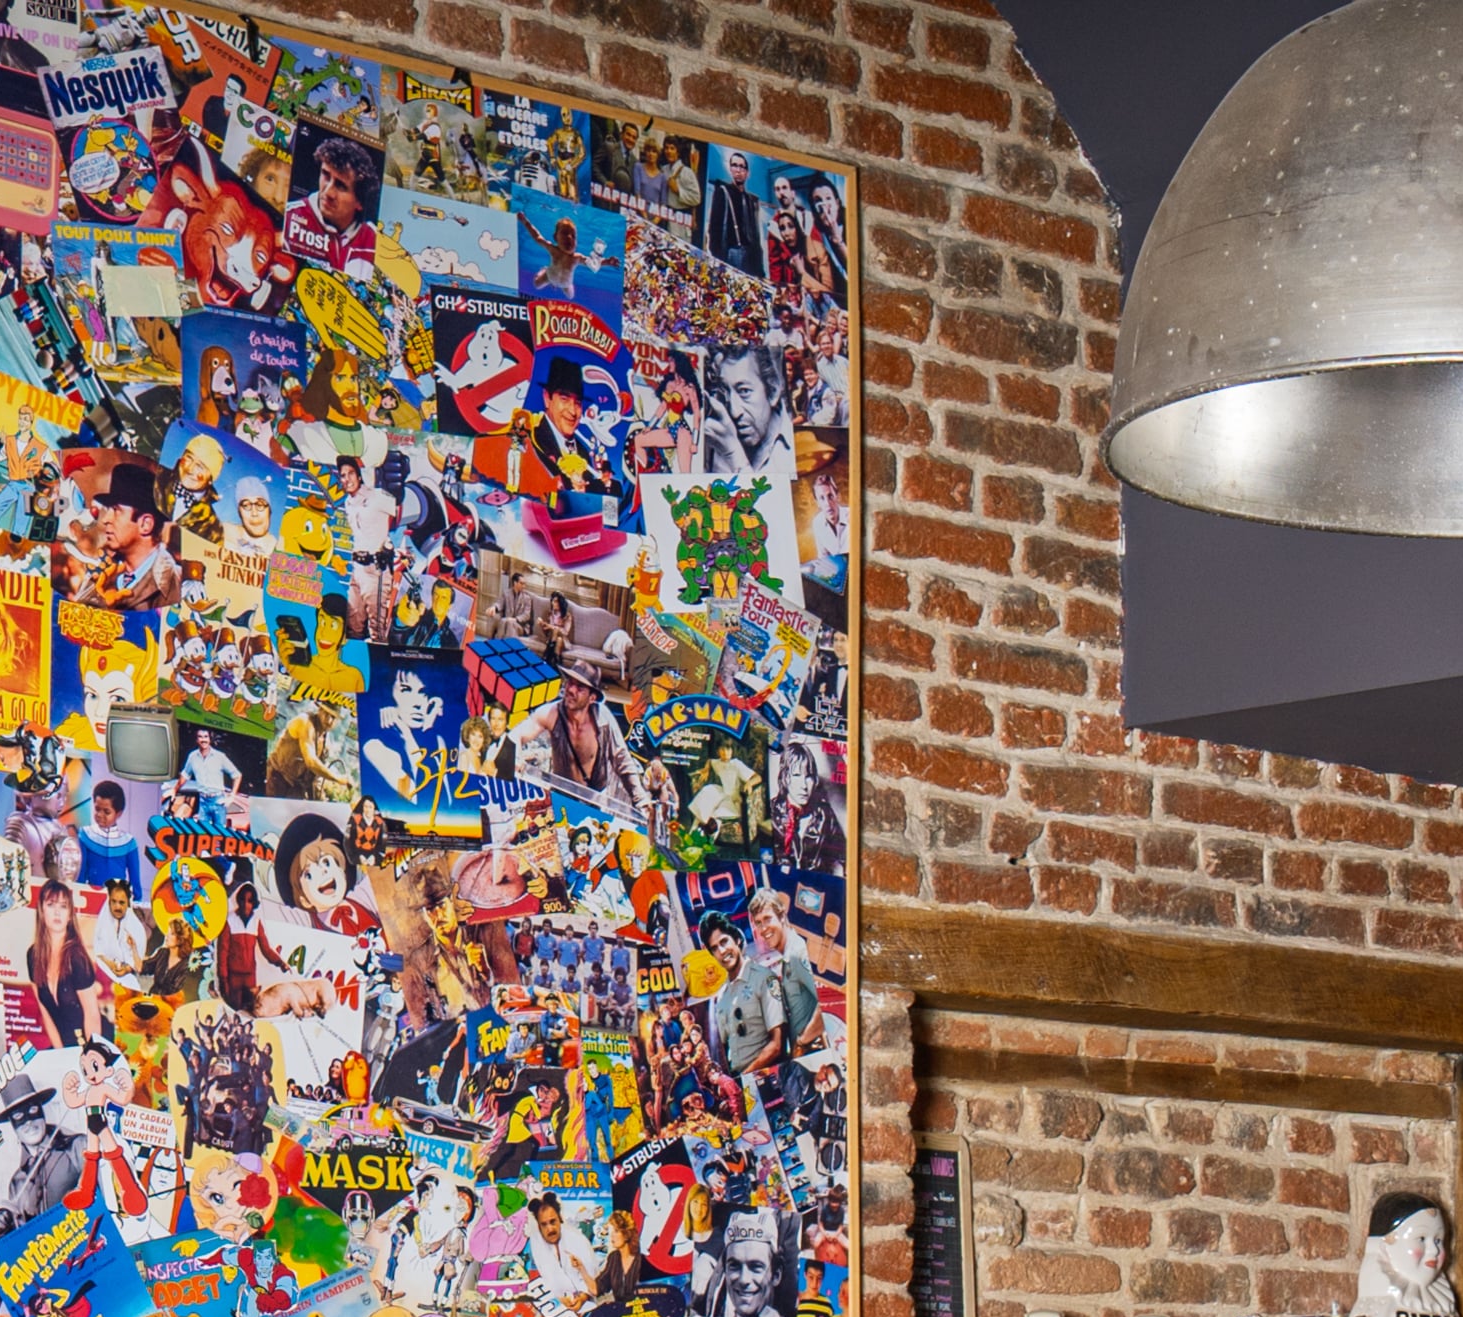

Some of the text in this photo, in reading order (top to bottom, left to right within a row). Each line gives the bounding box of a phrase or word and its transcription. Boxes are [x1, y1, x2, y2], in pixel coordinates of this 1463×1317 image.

[43, 56, 167, 119] Nesquik
[514, 95, 531, 110] LA
[496, 105, 548, 127] GUERRE
[510, 120, 536, 136] DES
[497, 133, 548, 152] ETOILES
[55, 223, 177, 246] TOUT DOUX DINKY
[289, 220, 331, 251] Prost
[536, 305, 618, 354] ROGER RABBIT
[27, 385, 83, 430] DAYS
[742, 583, 809, 634] Fantastic
[11, 698, 26, 721] GO
[32, 701, 46, 725] GO
[647, 702, 742, 738] PAC-MAN
[149, 819, 275, 868] SUPERMAN
[125, 1110, 172, 1126] EN CADEAU
[140, 1122, 168, 1135] ALBUM
[123, 1129, 167, 1144] VIGNETTES
[301, 1156, 415, 1193] MASK
[540, 1171, 599, 1188] BABAR
